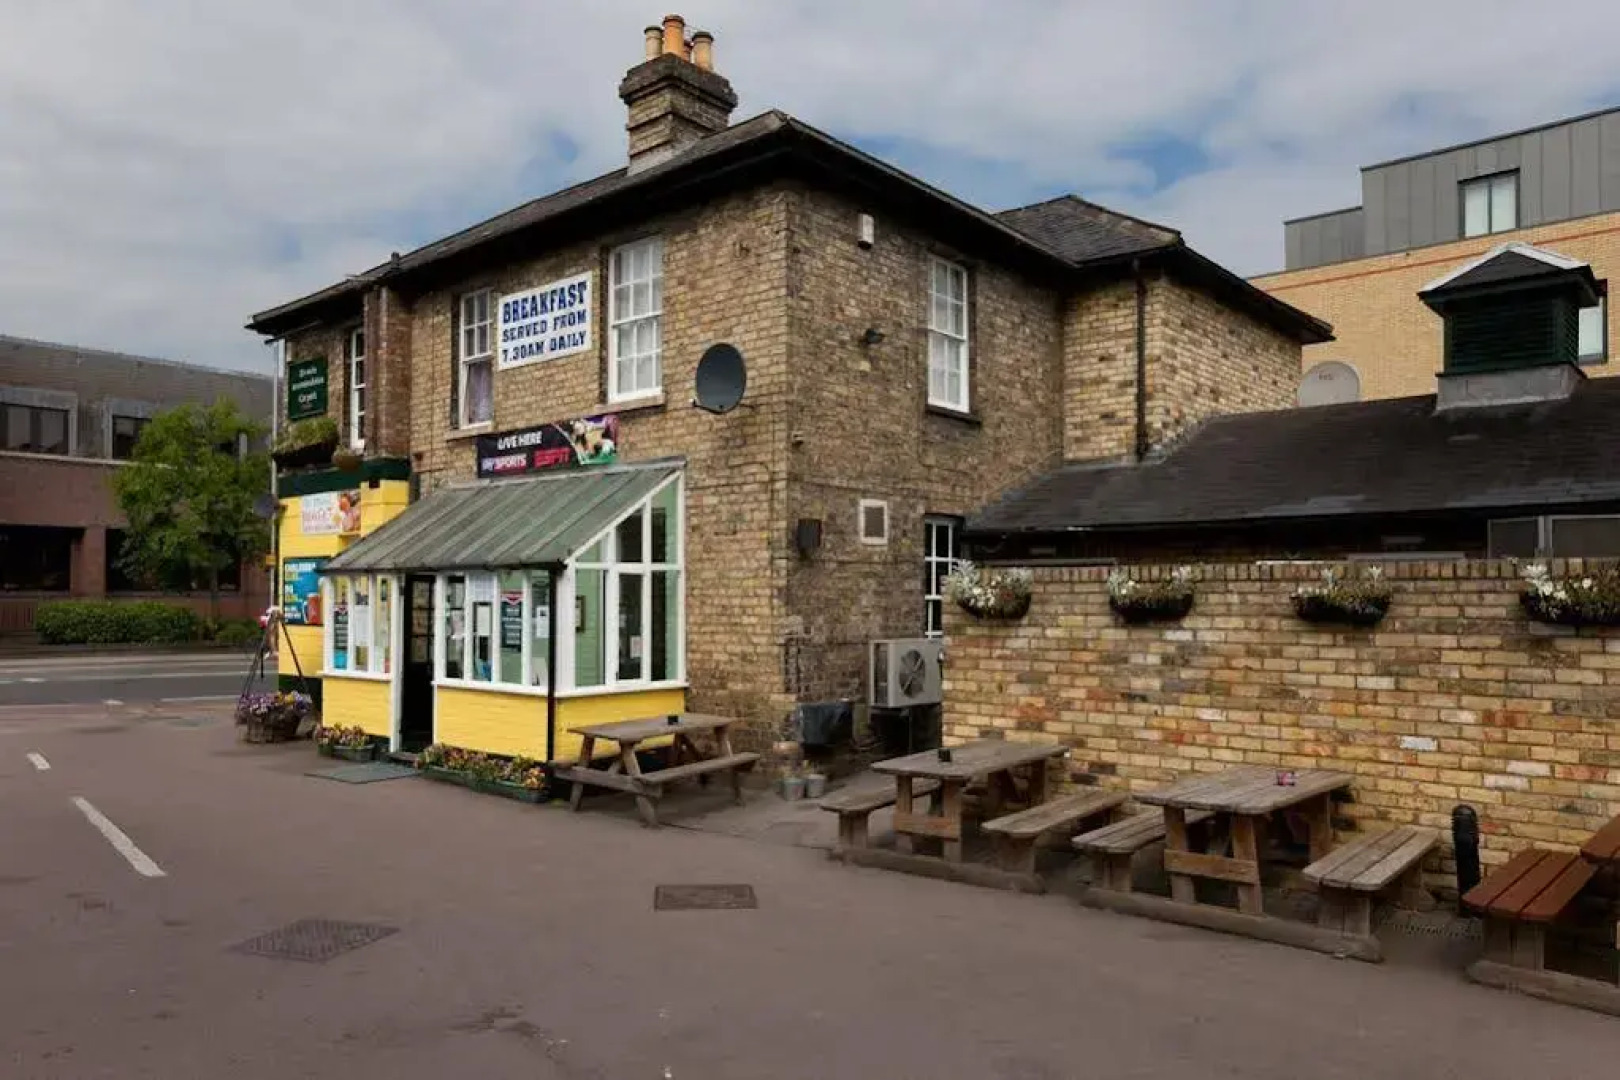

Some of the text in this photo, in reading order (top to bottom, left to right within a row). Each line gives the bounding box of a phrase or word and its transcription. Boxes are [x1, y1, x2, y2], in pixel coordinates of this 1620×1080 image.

[503, 281, 587, 324] BREAKFAST
[502, 309, 587, 342] SERVED FROM
[502, 331, 587, 362] 7.30AM DAILY
[497, 430, 543, 451] LIVE HERE
